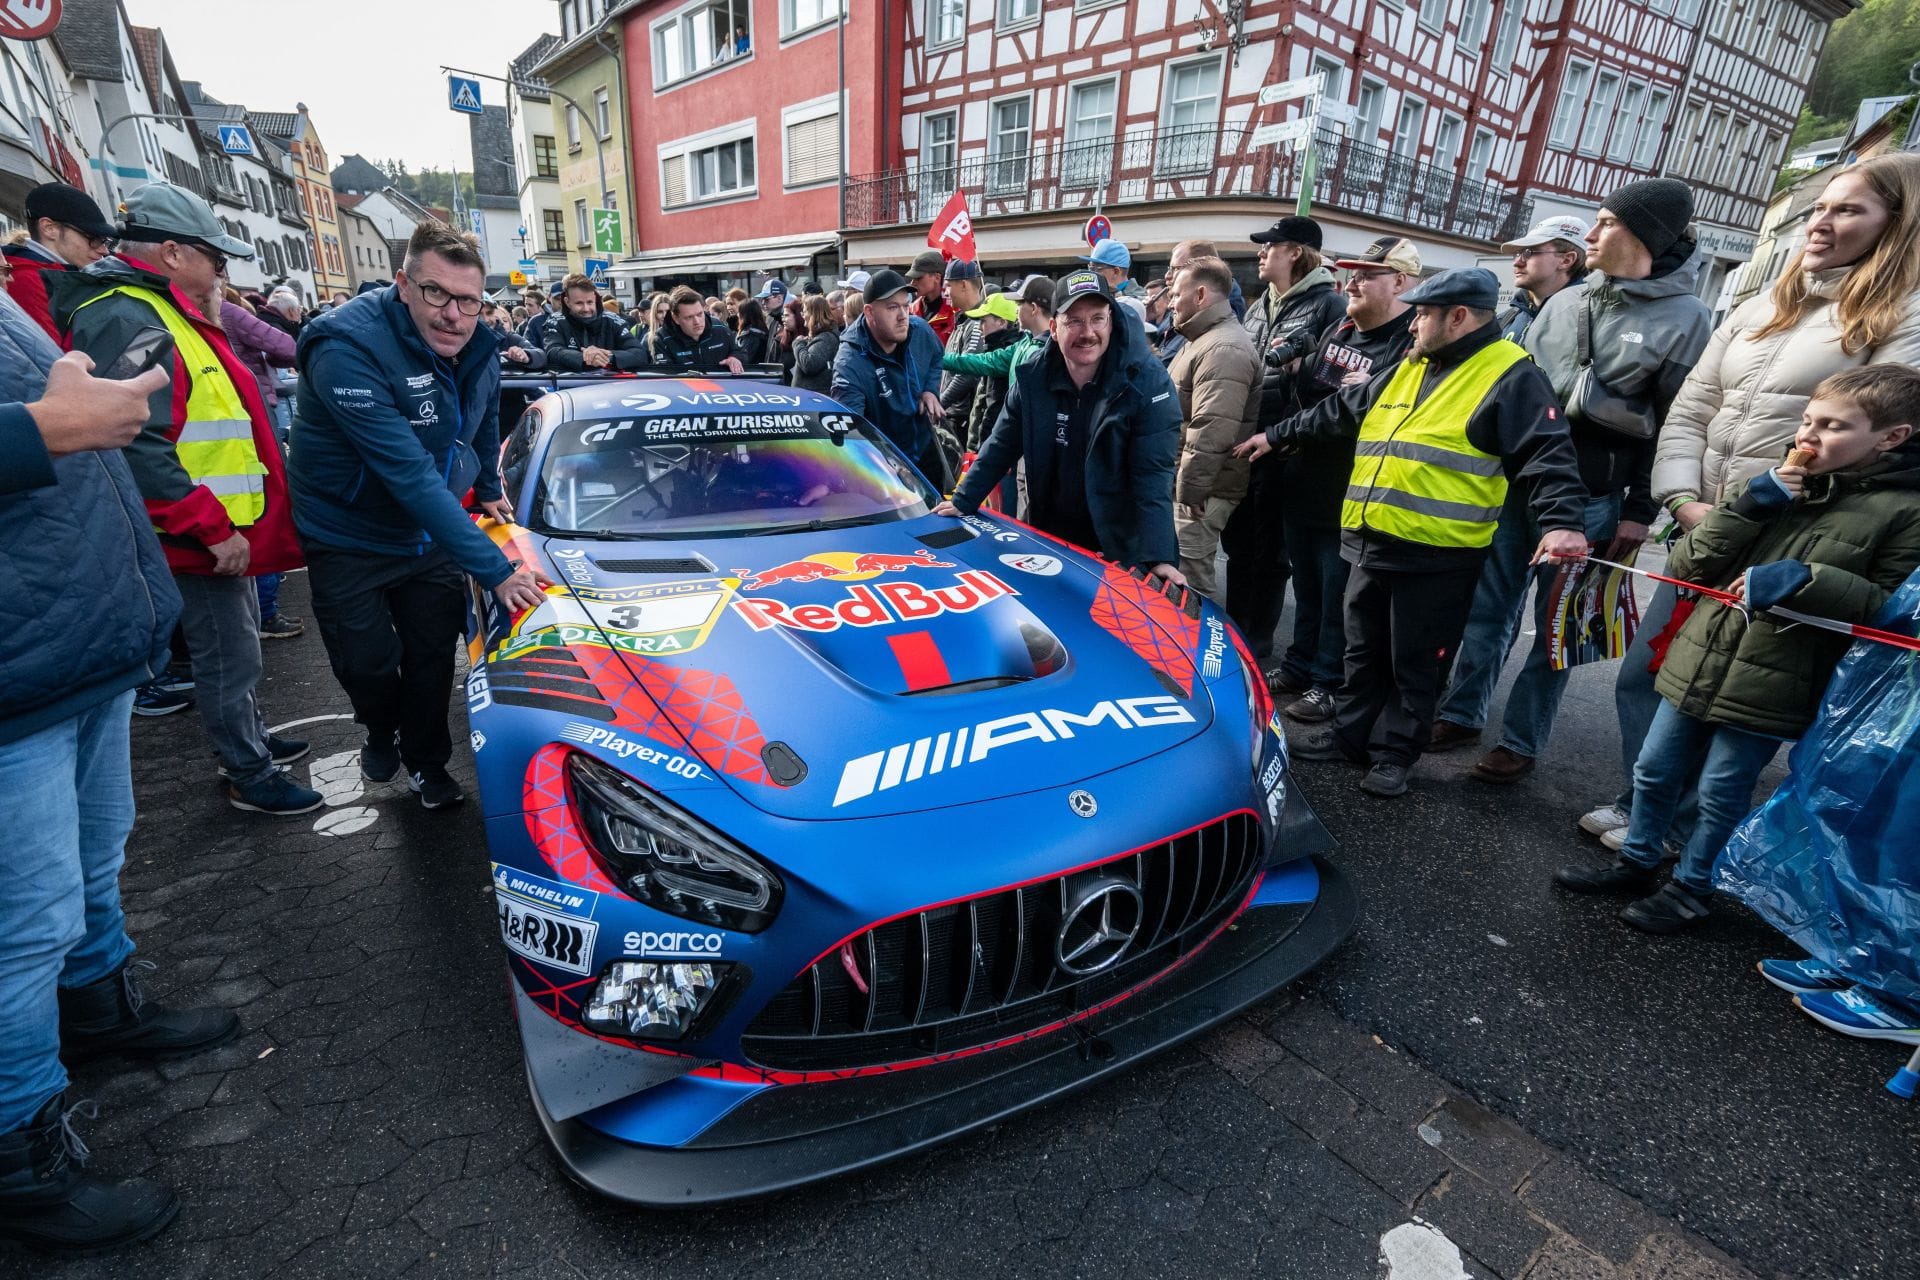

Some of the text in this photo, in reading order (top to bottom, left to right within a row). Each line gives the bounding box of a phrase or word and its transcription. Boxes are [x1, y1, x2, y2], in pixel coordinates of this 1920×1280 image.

[676, 392, 801, 408] viaplay
[644, 417, 713, 434] GRAN
[672, 431, 702, 439] REAL
[704, 429, 749, 438] DRIVING
[751, 427, 809, 436] SIMULATOR
[577, 583, 712, 600] RAVENOL
[730, 569, 1022, 632] Red Bull
[607, 605, 642, 630] 3
[560, 627, 683, 652] DEKRA
[968, 695, 1196, 763] AMG
[583, 726, 702, 779] Player 0.0
[509, 877, 585, 909] MICHELIN
[623, 931, 723, 957] sparco
